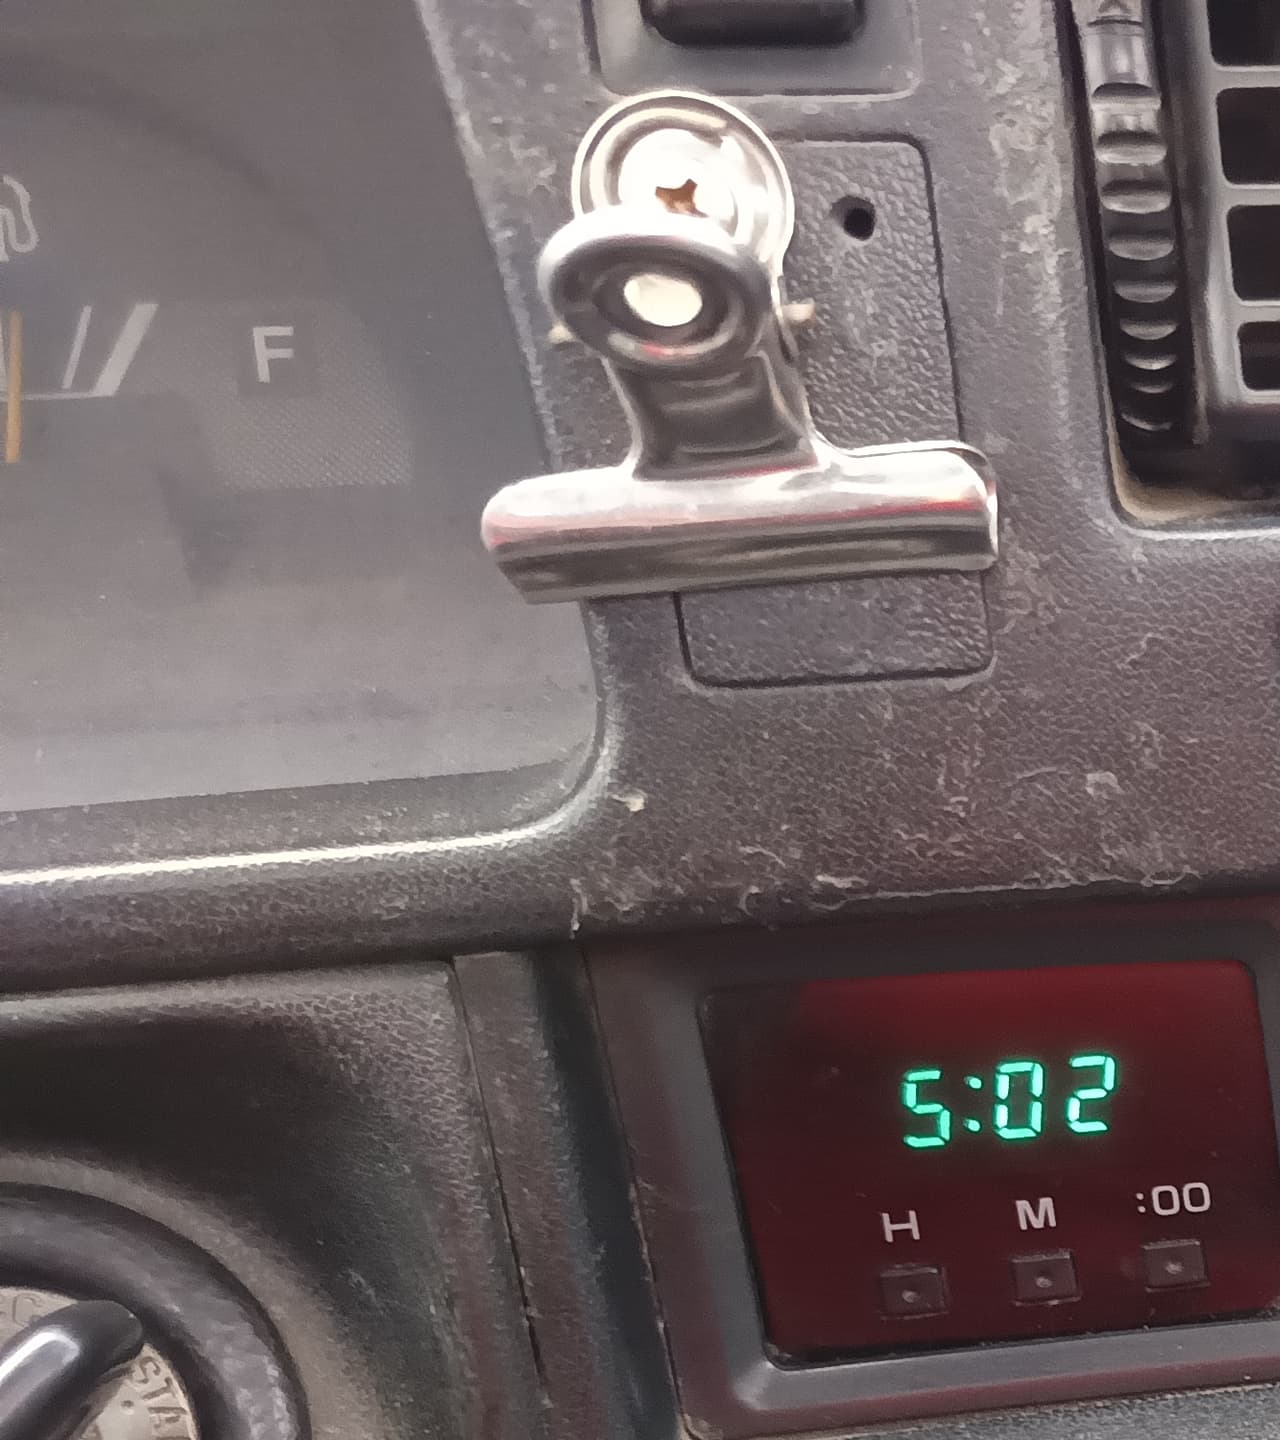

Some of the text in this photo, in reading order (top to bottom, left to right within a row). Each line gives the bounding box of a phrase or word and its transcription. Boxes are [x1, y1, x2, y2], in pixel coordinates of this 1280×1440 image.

[252, 325, 294, 384] F
[901, 1053, 1117, 1148] 5:02
[882, 1210, 920, 1243] H
[1015, 1196, 1057, 1231] M
